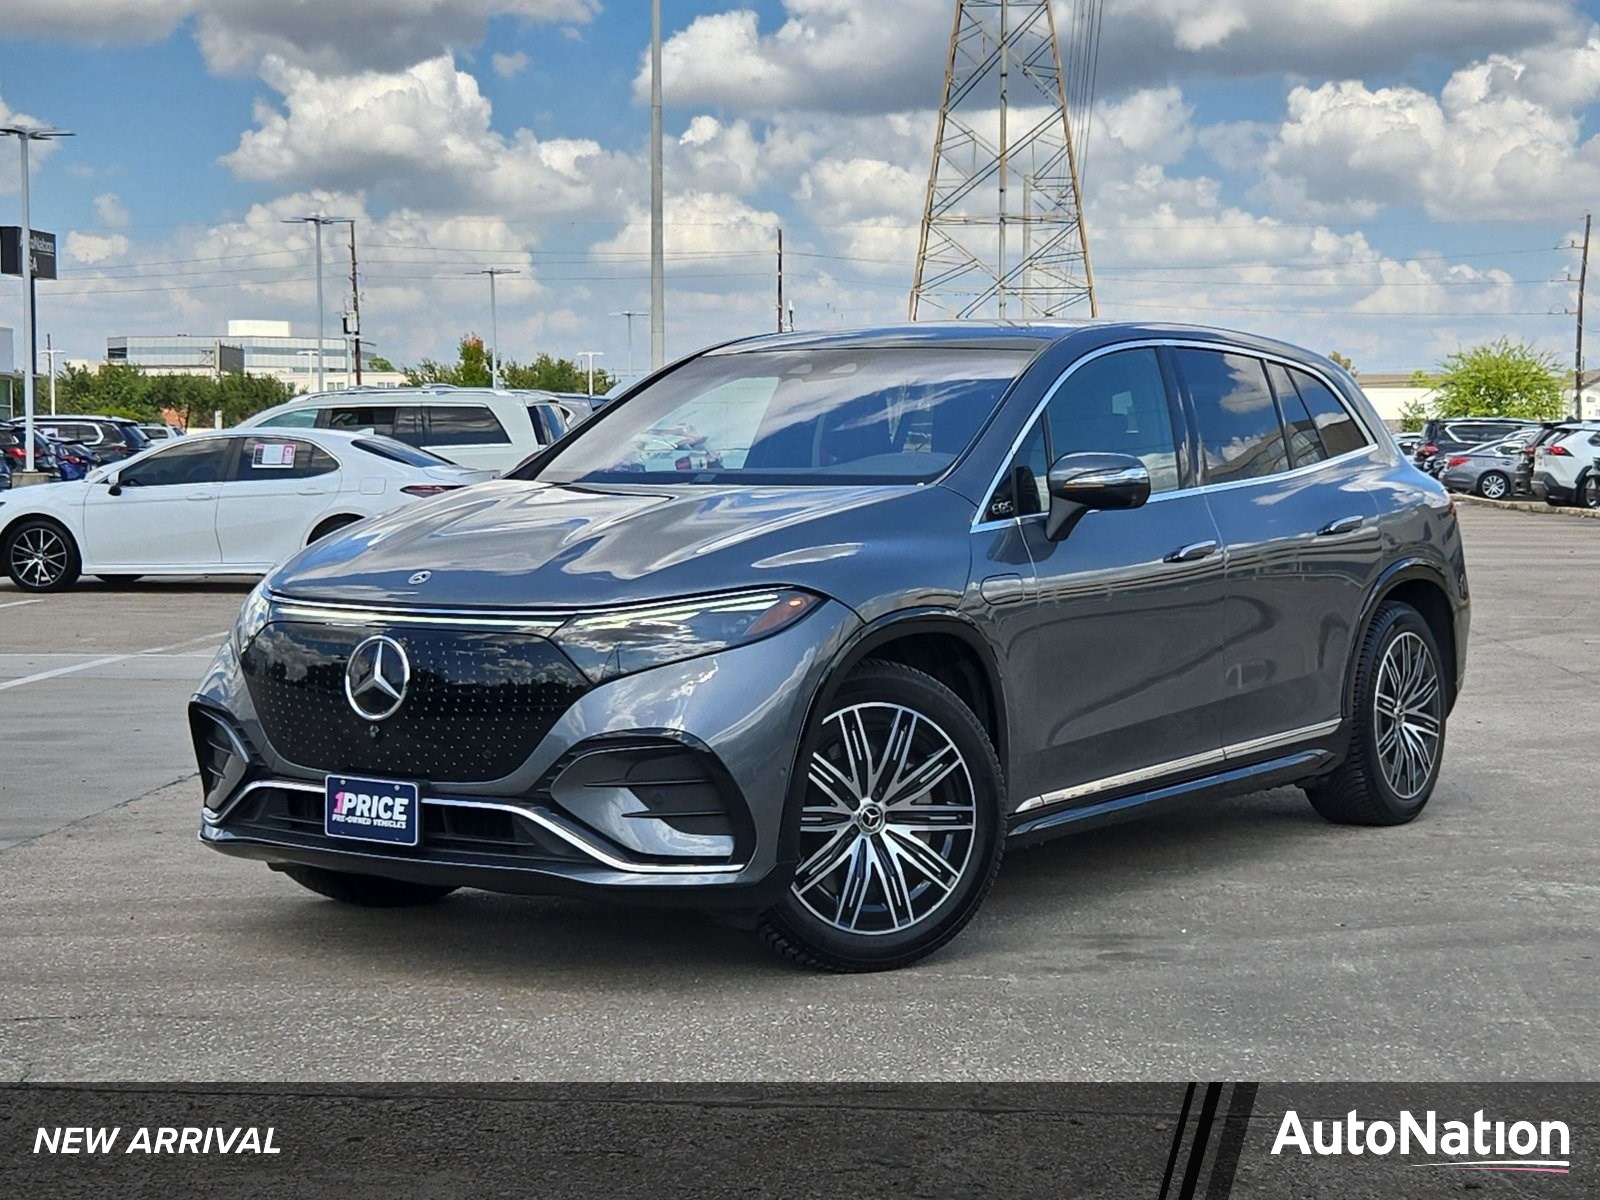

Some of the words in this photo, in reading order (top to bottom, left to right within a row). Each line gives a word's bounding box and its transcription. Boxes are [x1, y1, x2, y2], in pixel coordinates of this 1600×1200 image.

[991, 500, 1014, 515] EQS
[333, 791, 409, 821] 1PRICE
[332, 813, 372, 826] PRE-OWNED
[373, 818, 407, 829] VEHICLES
